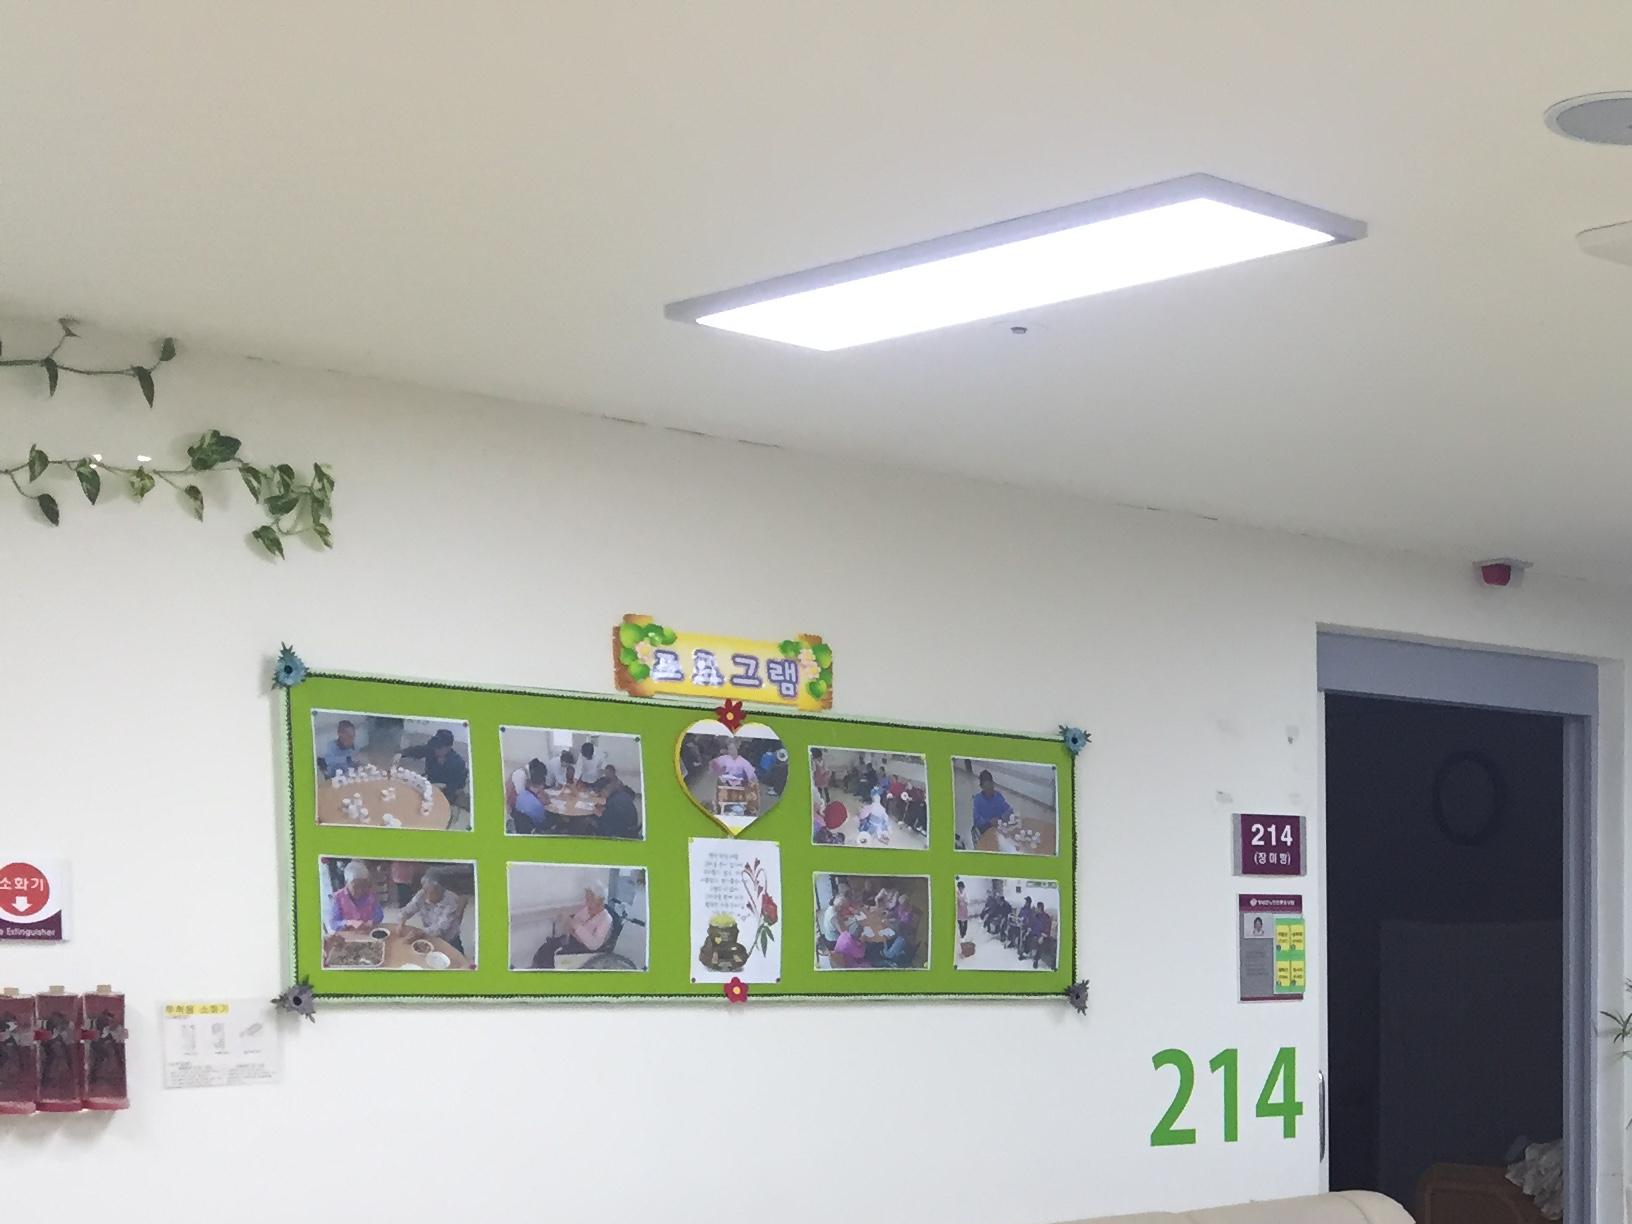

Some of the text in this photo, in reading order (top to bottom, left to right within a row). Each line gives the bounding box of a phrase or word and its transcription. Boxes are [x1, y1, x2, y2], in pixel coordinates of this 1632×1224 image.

[1251, 823, 1293, 847] 214
[0, 877, 44, 892] 소화기
[6, 927, 55, 937] Extinguisher
[1150, 1047, 1303, 1147] 214
